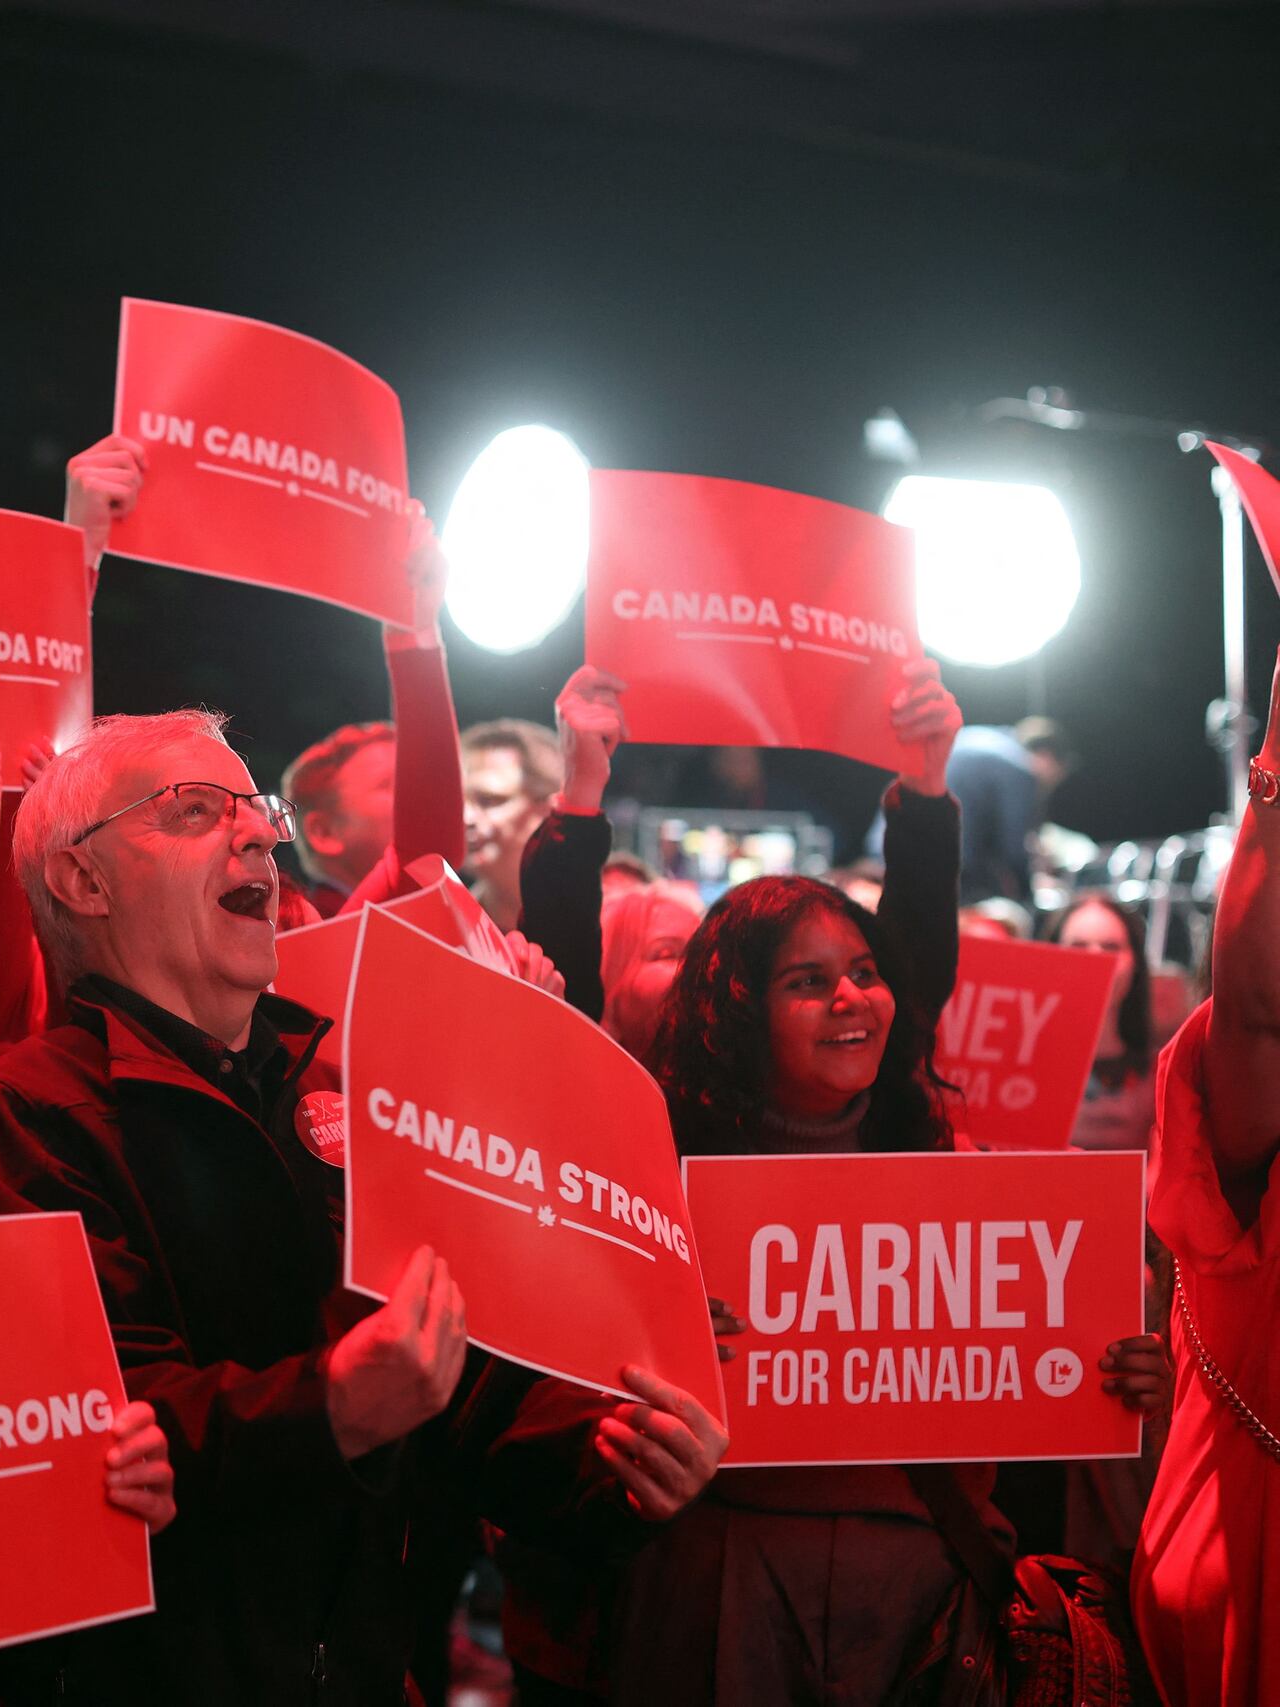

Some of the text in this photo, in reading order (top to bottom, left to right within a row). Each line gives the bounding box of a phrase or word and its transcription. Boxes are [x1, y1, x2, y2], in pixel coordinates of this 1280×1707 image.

[139, 411, 404, 515] UN CANADA FORT
[36, 637, 84, 675] FORT
[612, 587, 909, 658] CANADA STRONG
[942, 980, 1062, 1065] NEY
[367, 1087, 691, 1265] CANADA STRONG
[748, 1219, 1084, 1335] CARNEY
[747, 1345, 1023, 1406] FOR CANADA
